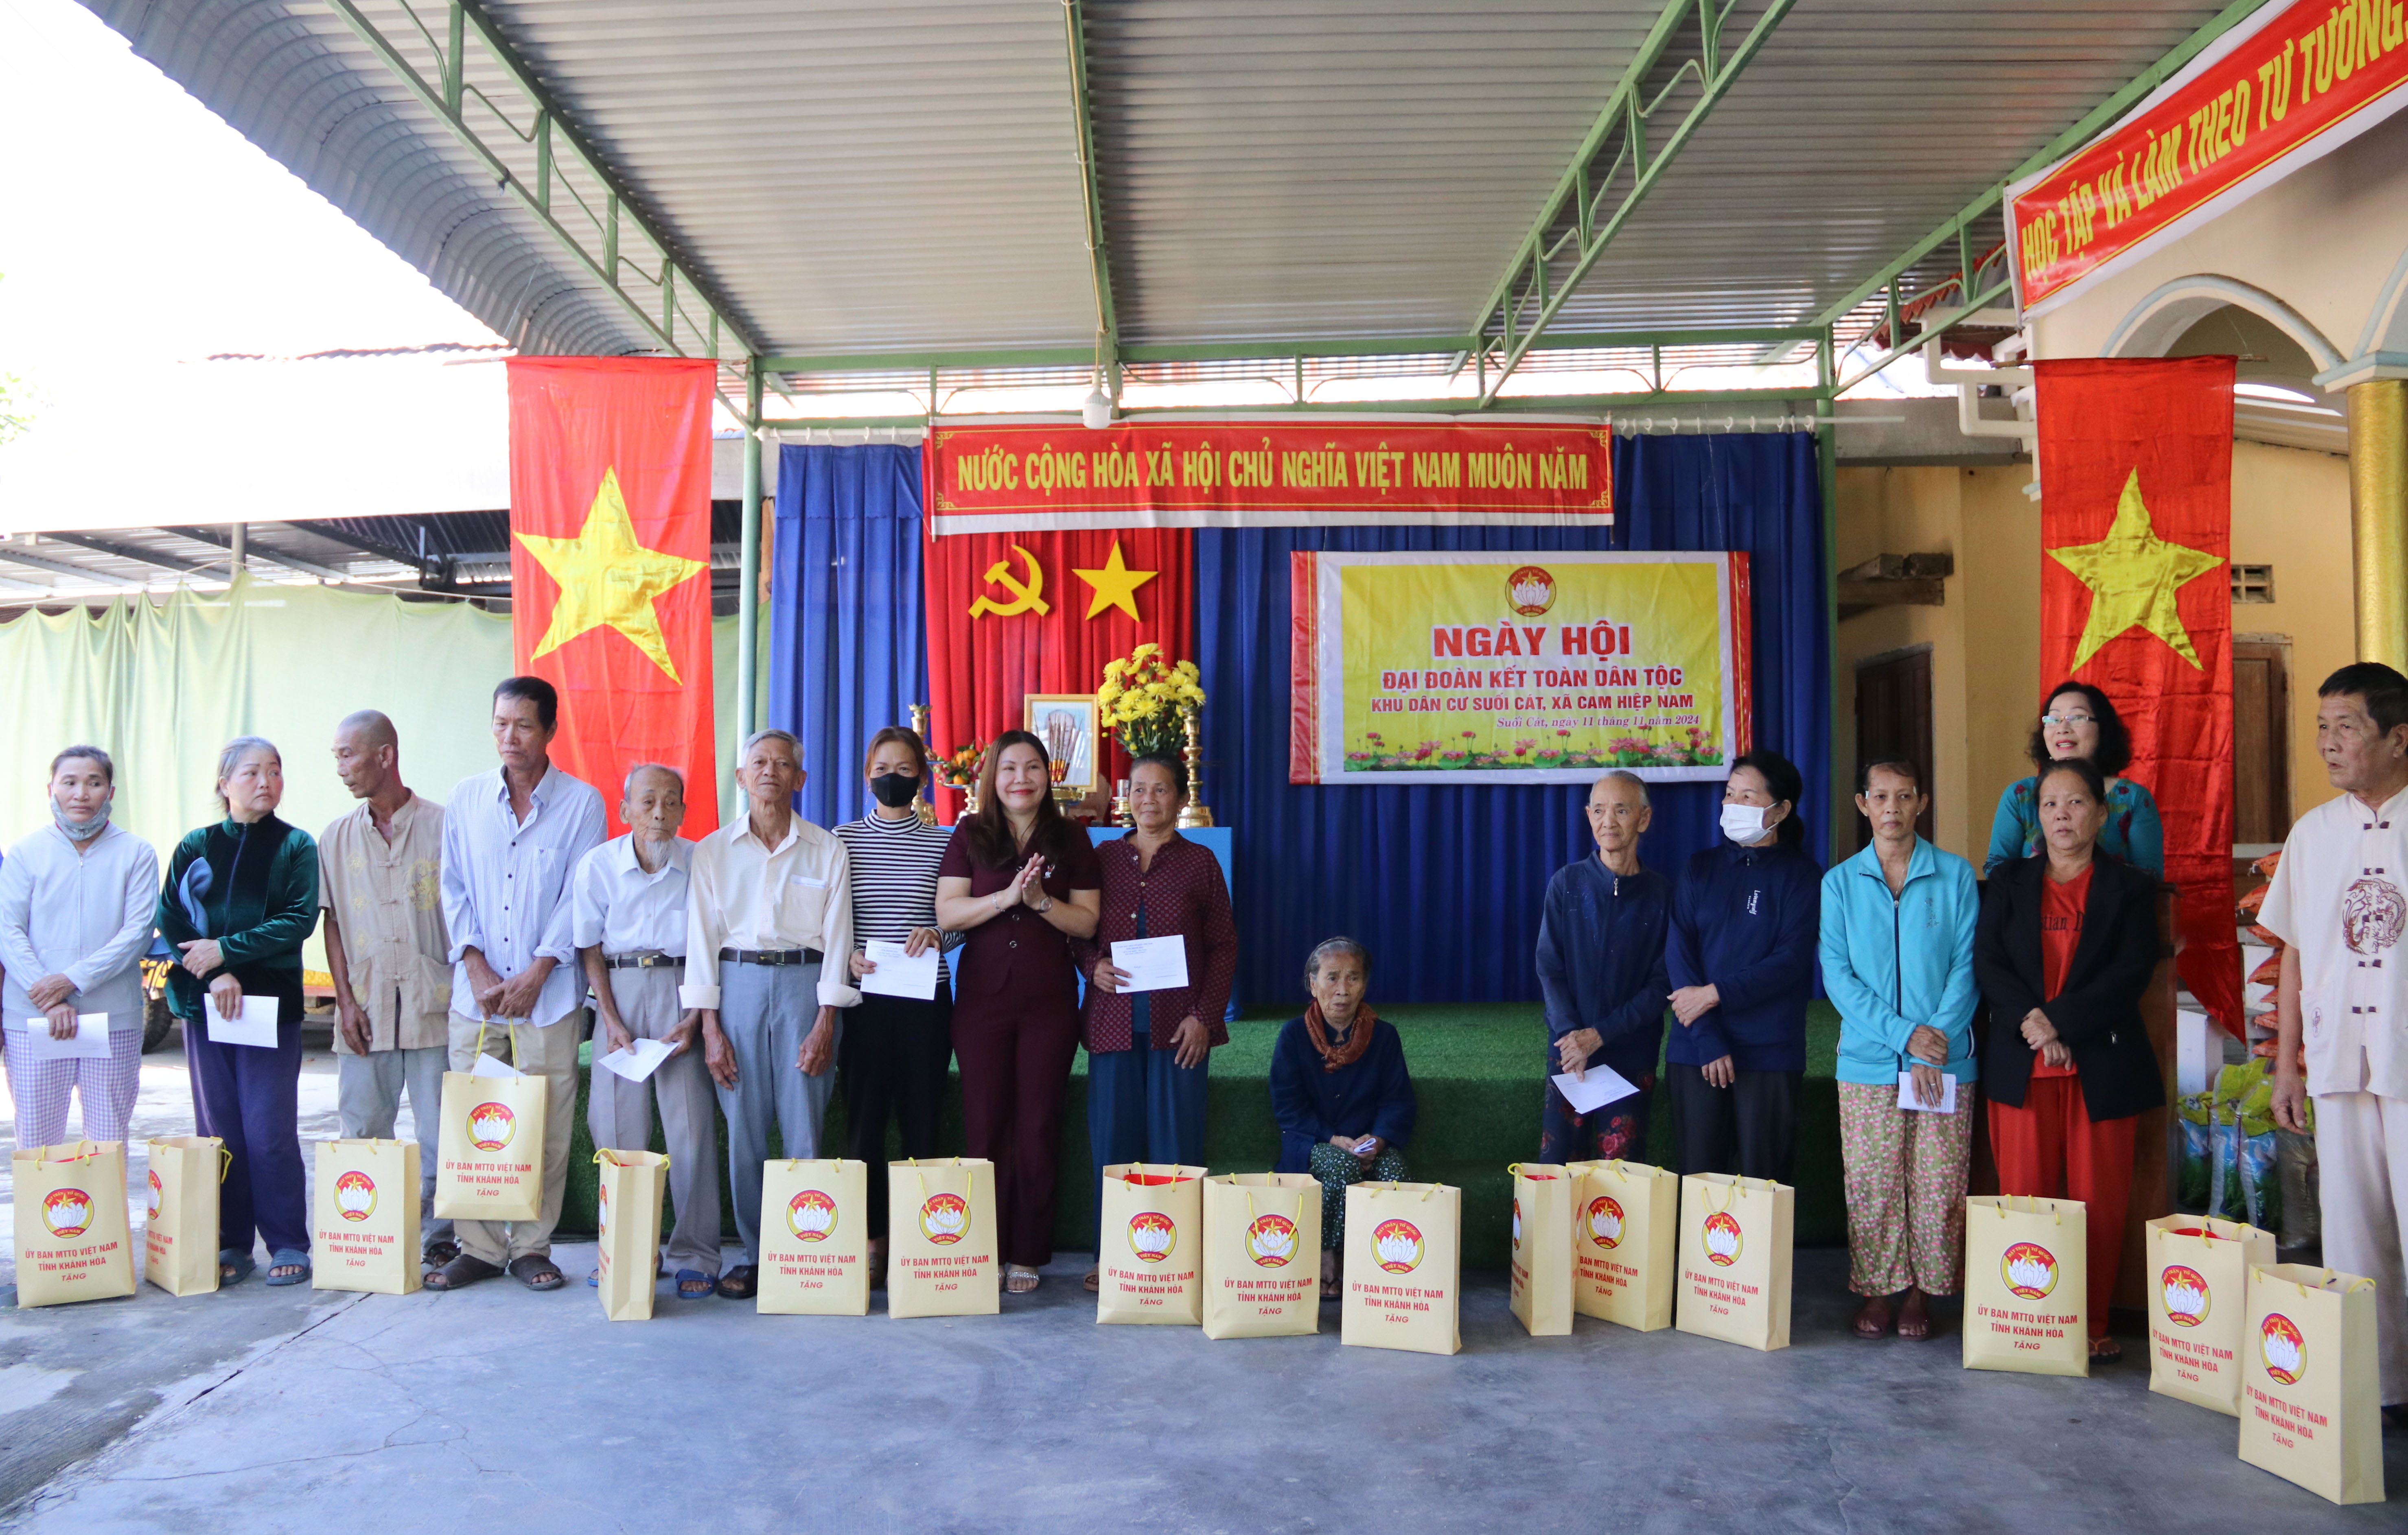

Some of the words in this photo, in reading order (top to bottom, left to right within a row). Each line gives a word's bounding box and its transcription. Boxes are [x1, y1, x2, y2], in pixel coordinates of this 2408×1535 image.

[2022, 209, 2059, 284] HỌC
[2058, 180, 2096, 260] TẬP
[2098, 151, 2132, 229] VÀ
[2131, 124, 2183, 210] LÀM
[2188, 79, 2250, 175] THEO
[2258, 38, 2294, 131] TƯ
[958, 444, 1018, 491] NƯỚC
[1025, 443, 1086, 496] CỘNG
[1093, 442, 1139, 488] HÒA
[1146, 441, 1174, 487] XÃ
[1183, 441, 1220, 494] HỘI
[1228, 437, 1273, 487] CHỦ
[1282, 442, 1348, 488] NGHĨA
[1355, 441, 1405, 495] VIỆT
[1413, 452, 1460, 488] NAM
[1468, 443, 1532, 489] MUÔN
[1540, 446, 1587, 489] NĂM
[1434, 621, 1546, 656] NGÀY
[1562, 620, 1630, 661] HỘI
[1383, 671, 1417, 693] ĐẠI
[1425, 667, 1482, 688] ĐOÀN
[1489, 665, 1527, 688] KẾT
[1533, 667, 1587, 687] TOÀN
[1595, 665, 1636, 687] DÂN
[1643, 665, 1681, 689] TỘC
[1372, 698, 1403, 712] KHU
[1409, 695, 1441, 711] DÂN
[1447, 697, 1468, 711] CƯ
[1472, 693, 1508, 710] SUỐI
[1515, 694, 1546, 711] CÁT,
[1552, 694, 1572, 709] XÃ
[1578, 695, 1611, 709] CAM
[1617, 693, 1652, 711] HIỆP
[1657, 695, 1693, 708] NAM
[1497, 716, 1522, 727] Suối
[1526, 716, 1548, 727] Cát,
[1552, 717, 1578, 728] ngày
[1583, 717, 1593, 726] 11
[1598, 716, 1629, 728] tháng
[1633, 716, 1644, 725] 11
[1648, 715, 1672, 725] năm
[1675, 715, 1699, 724] 2024
[2041, 911, 2067, 930] tian
[446, 1160, 454, 1169] ỦY
[497, 1162, 512, 1173] VIỆT
[458, 1173, 474, 1183] TỈNH
[476, 1175, 501, 1183] KHÁNH
[504, 1175, 519, 1184] HÒA
[26, 1247, 34, 1258] ỦY
[56, 1249, 77, 1258] MTTQ
[80, 1245, 96, 1256] VIỆT
[99, 1242, 117, 1252] NAM
[768, 1251, 777, 1261] ỦY
[797, 1255, 817, 1263] MTTQ
[820, 1254, 835, 1264] VIỆT
[39, 1260, 56, 1271] TỈNH
[59, 1259, 87, 1270] KHÁNH
[90, 1256, 106, 1266] HÒA
[901, 1256, 910, 1266] ỦY
[932, 1257, 951, 1266] MTTQ
[954, 1255, 970, 1266] VIỆT
[972, 1255, 989, 1263] NAM
[780, 1265, 797, 1275] TỈNH
[799, 1267, 825, 1275] KHÁNH
[828, 1268, 843, 1276] HÒA
[914, 1269, 931, 1279] TỈNH
[934, 1269, 959, 1278] KHÁNH
[962, 1268, 977, 1277] HÒA
[1109, 1266, 1117, 1276] ỦY
[1120, 1270, 1134, 1279] BAN
[1136, 1273, 1157, 1282] MTTQ
[1160, 1273, 1176, 1284] VIỆT
[1178, 1271, 1194, 1281] NAM
[1120, 1283, 1136, 1292] TỈNH
[1139, 1285, 1165, 1293] KHÁNH
[1168, 1285, 1183, 1294] HÒA
[1225, 1277, 1234, 1288] ỦY
[1237, 1280, 1254, 1288] BAN
[1256, 1281, 1277, 1289] MTTQ
[1280, 1279, 1296, 1290] VIỆT
[1298, 1278, 1312, 1287] NAM
[1353, 1281, 1362, 1291] ỦY
[1364, 1284, 1379, 1293] BAN
[1382, 1286, 1403, 1296] MTTQ
[1406, 1287, 1422, 1298] VIỆT
[1425, 1290, 1443, 1298] NAM
[1238, 1292, 1255, 1301] TỈNH
[1258, 1293, 1285, 1302] KHÁNH
[1287, 1292, 1301, 1301] HÒA
[1365, 1296, 1382, 1307] TỈNH
[1385, 1299, 1411, 1310] KHÁNH
[1413, 1302, 1429, 1311] HÒA
[1979, 1304, 1988, 1315] ỦY
[1991, 1309, 2008, 1319] BAN
[2012, 1312, 2034, 1323] MTTQ
[2038, 1313, 2056, 1326] VIỆT
[2059, 1315, 2077, 1324] NAM
[1992, 1321, 2010, 1333] TỈNH
[2014, 1325, 2043, 1336] KHÁNH
[2047, 1328, 2064, 1338] HÒA
[2158, 1333, 2170, 1345] BAN
[2172, 1338, 2191, 1351] MTTQ
[2194, 1343, 2210, 1356] VIỆT
[2213, 1348, 2233, 1360] NAM
[2160, 1347, 2173, 1360] TỈNH
[2175, 1353, 2200, 1368] KHÁNH
[2202, 1360, 2218, 1372] HÒA
[2247, 1384, 2253, 1396] ỦY
[2255, 1389, 2267, 1403] BAN
[2270, 1396, 2287, 1413] MTTQ
[2290, 1404, 2305, 1420] VIỆT
[2308, 1411, 2327, 1427] NAM
[2256, 1406, 2269, 1421] TỈNH
[2271, 1414, 2295, 1432] KHÁNH
[2298, 1424, 2313, 1439] HÒA
